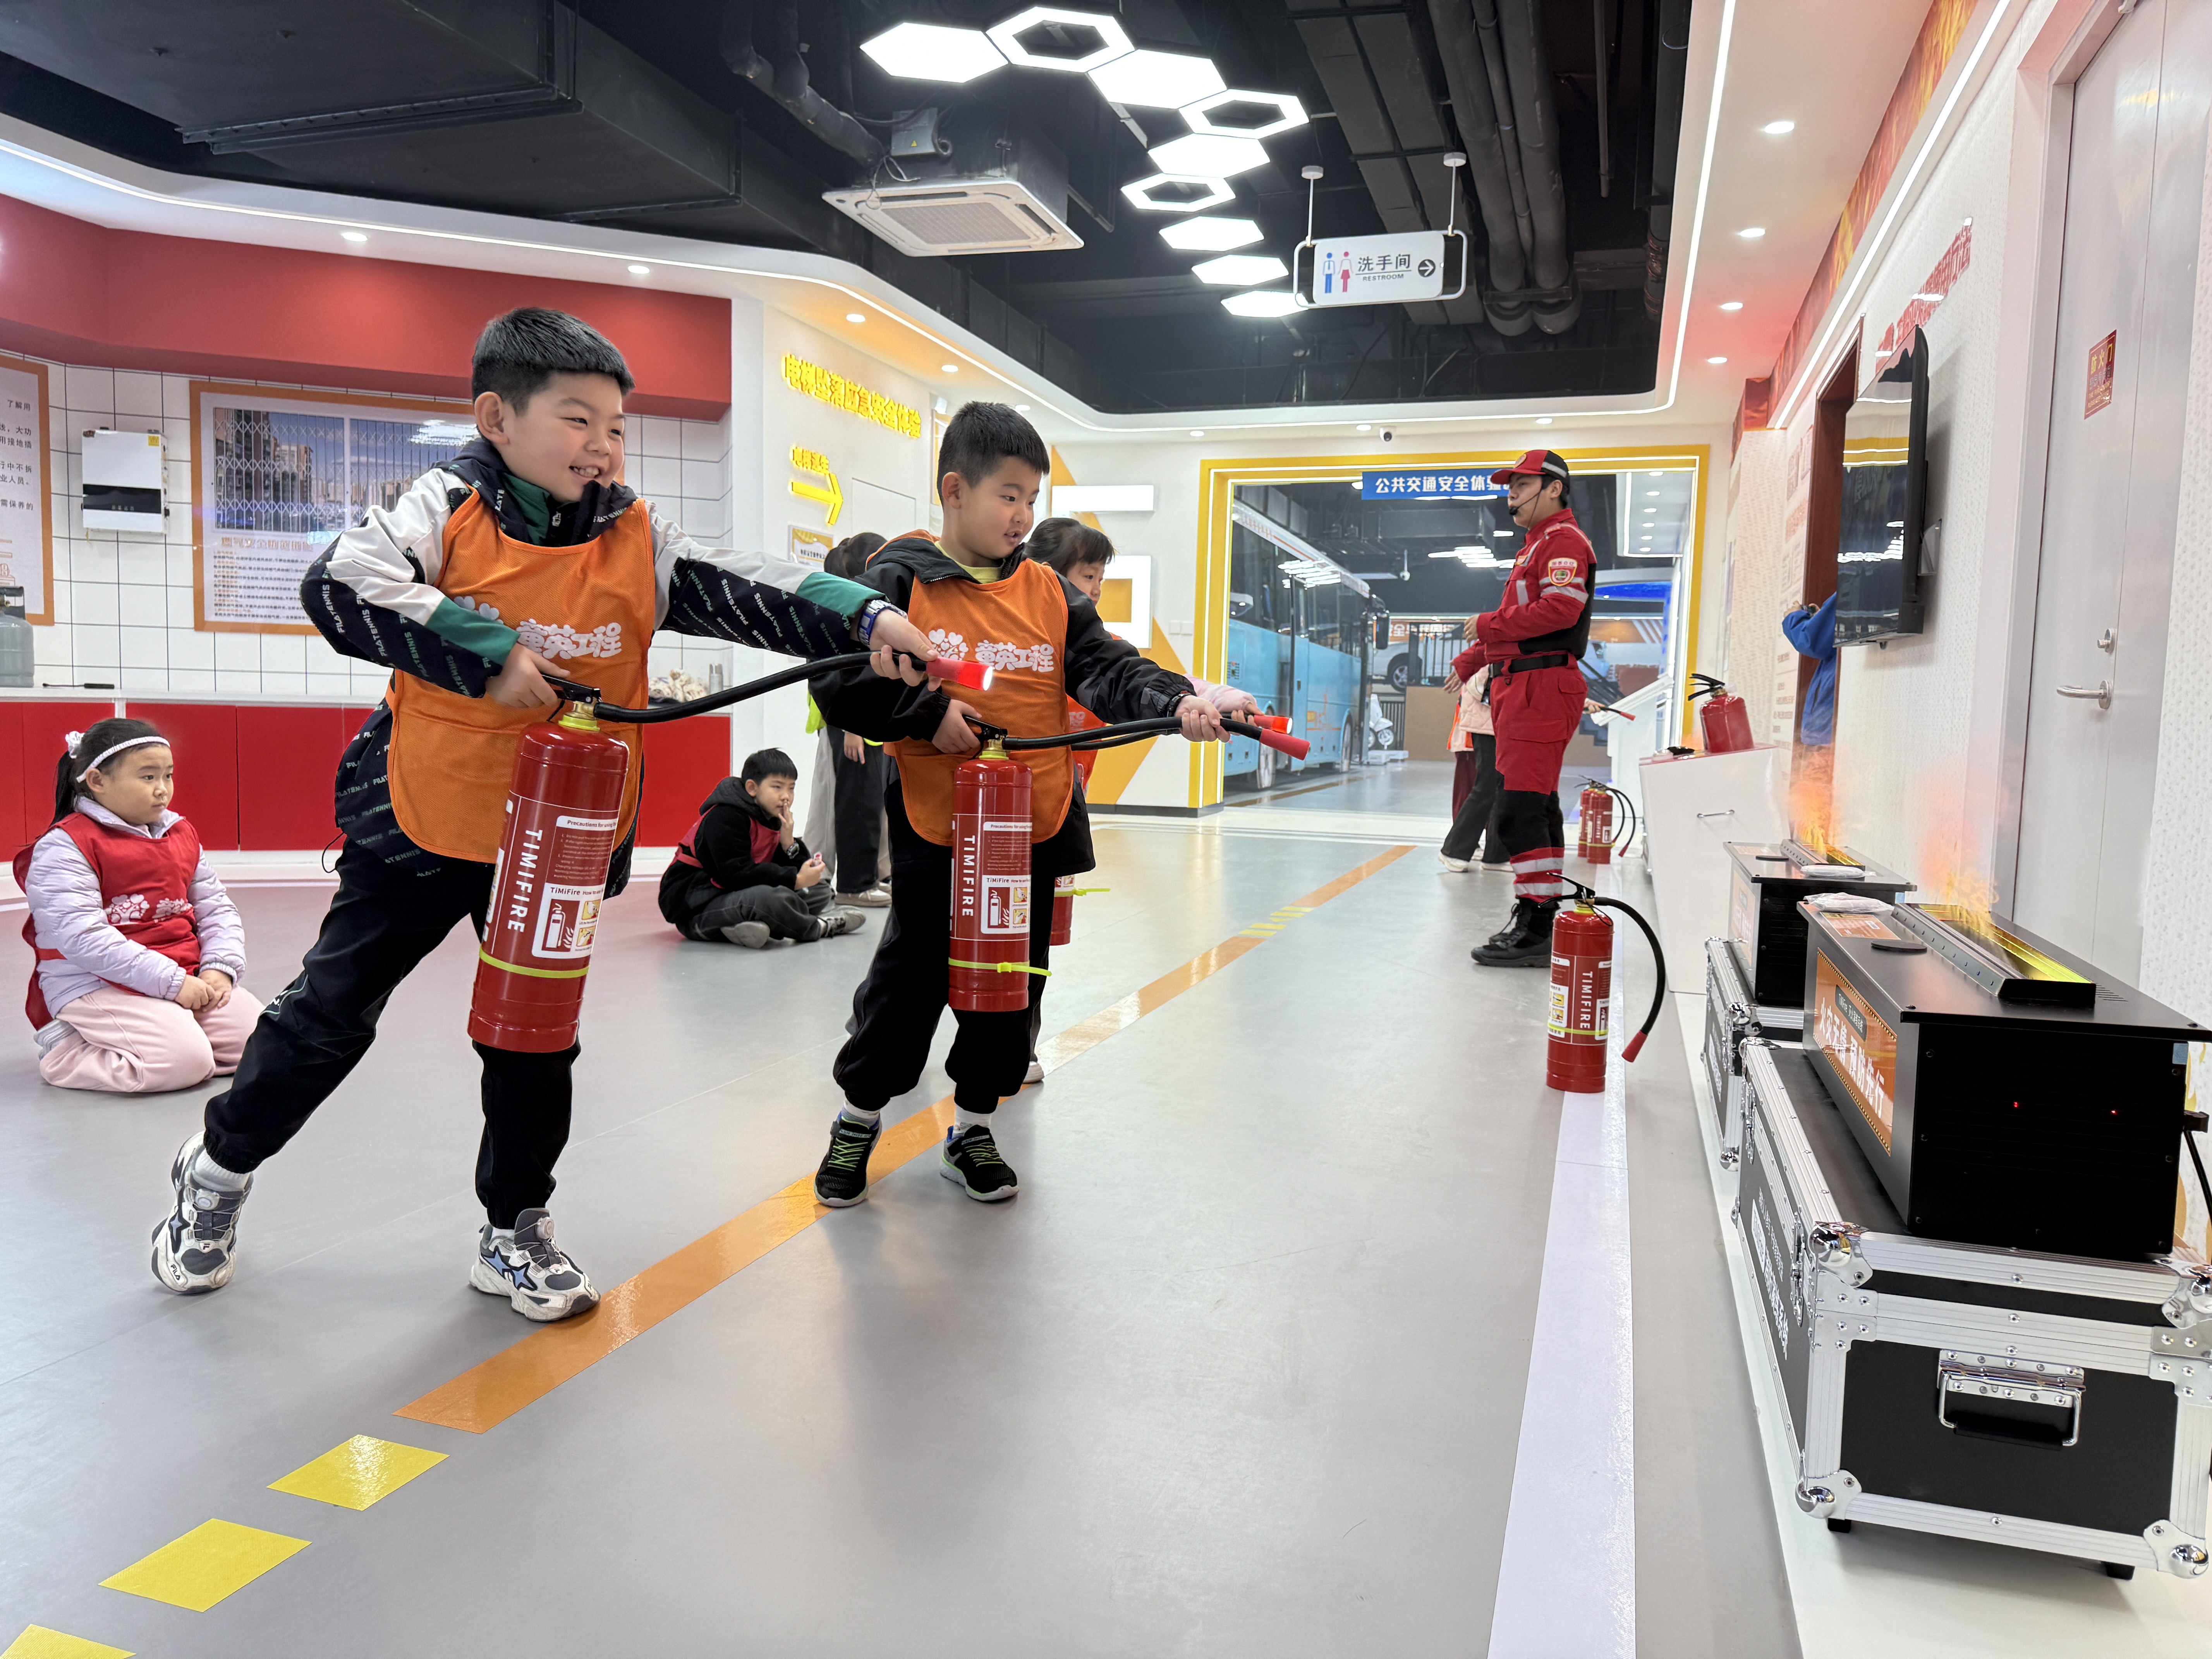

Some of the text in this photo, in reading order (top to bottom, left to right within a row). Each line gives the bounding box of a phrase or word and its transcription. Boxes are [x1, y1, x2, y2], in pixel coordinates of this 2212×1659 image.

[1358, 254, 1411, 272] 洗手间
[322, 584, 346, 634] FILATENNIS
[362, 608, 388, 657] FILATENNIS
[515, 618, 622, 660] 童英工程
[974, 639, 1054, 673] 童英工程
[507, 829, 543, 934] TIMIFIRE
[550, 887, 580, 895] TiMiFire
[962, 835, 975, 917] TIMIFIRE
[1580, 971, 1593, 1029] TIMIFIRE
[1819, 997, 1885, 1119] 火灾无情 预防先行
[170, 1264, 180, 1280] FILA
